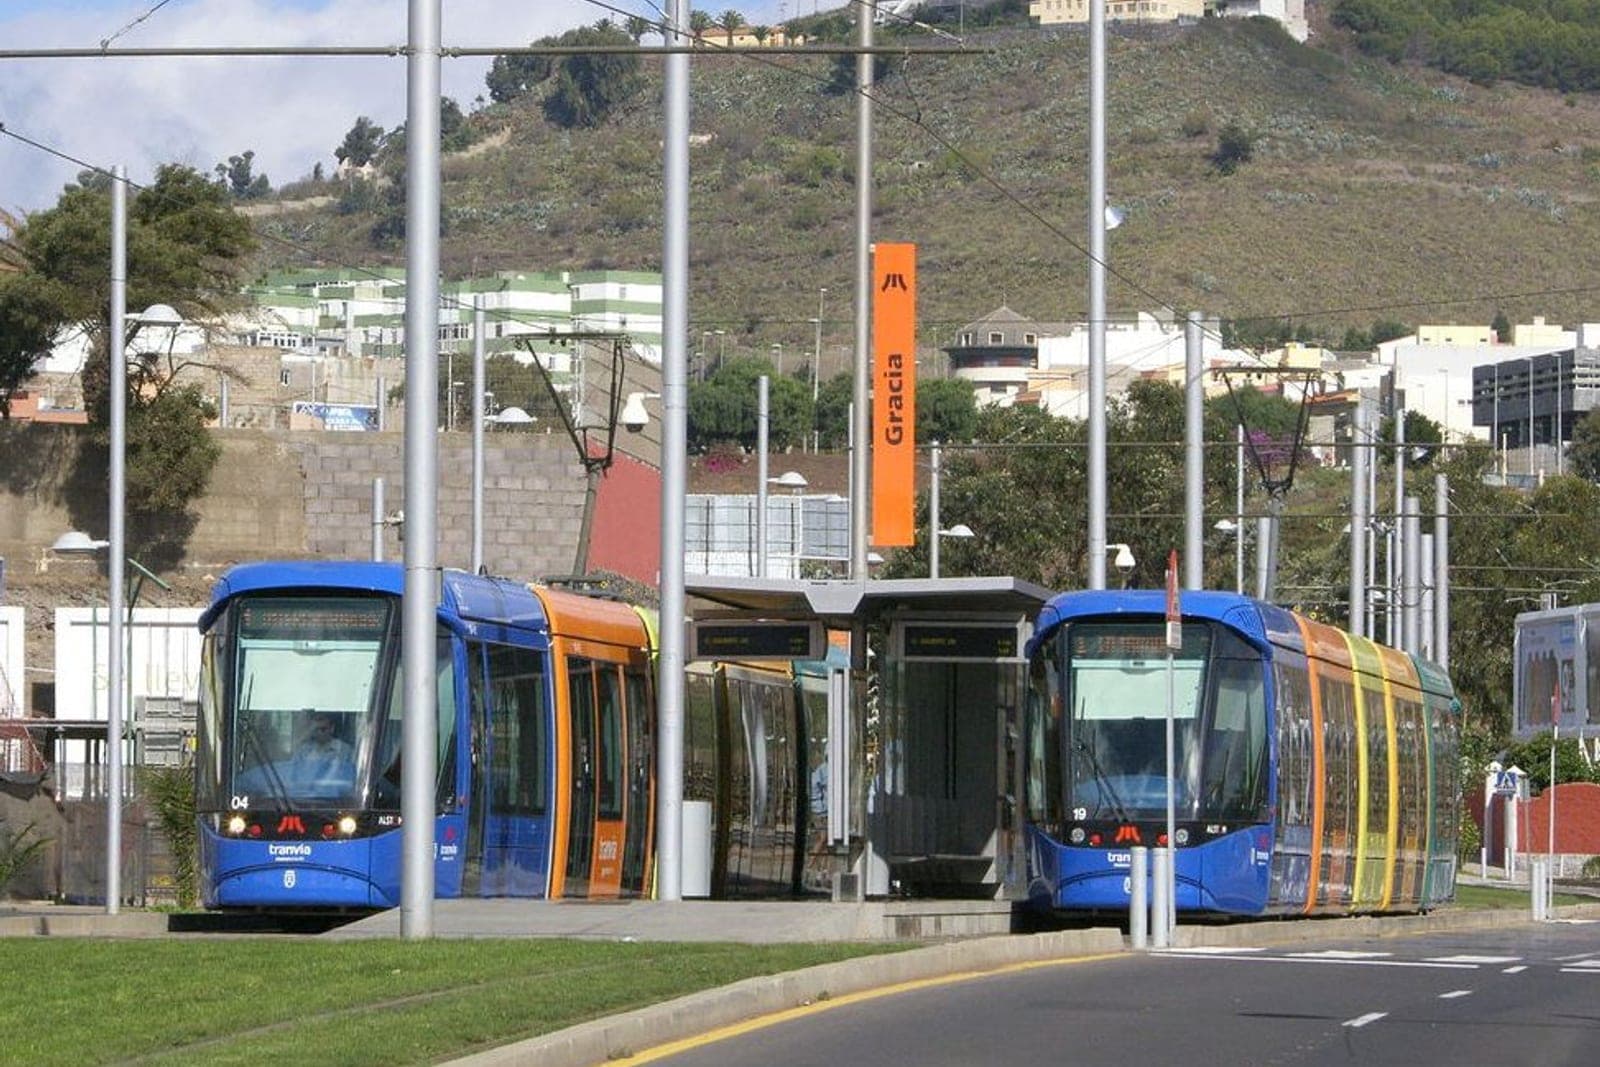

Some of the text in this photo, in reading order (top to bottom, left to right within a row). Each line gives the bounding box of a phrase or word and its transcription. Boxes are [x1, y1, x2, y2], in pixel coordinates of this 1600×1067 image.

[884, 353, 903, 446] Gracia
[231, 796, 249, 810] 04
[1072, 807, 1087, 821] 19
[1107, 852, 1132, 863] tran
